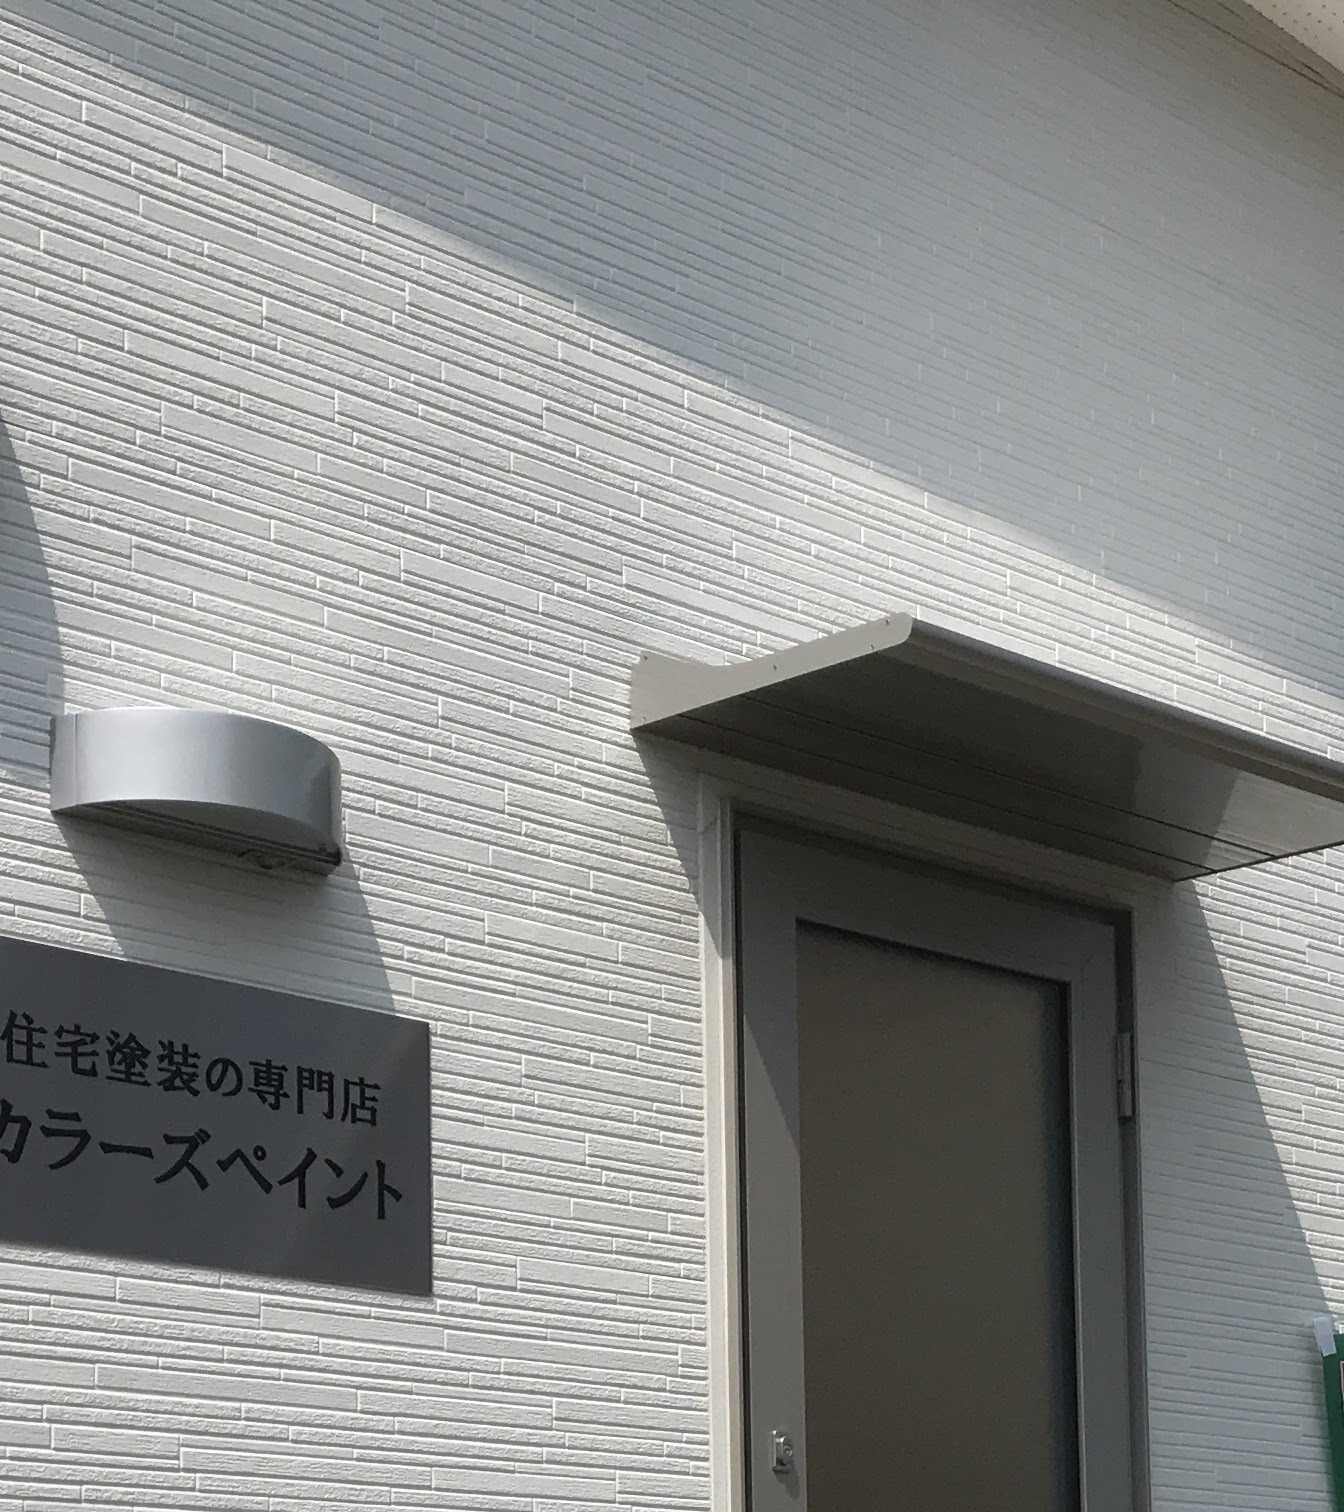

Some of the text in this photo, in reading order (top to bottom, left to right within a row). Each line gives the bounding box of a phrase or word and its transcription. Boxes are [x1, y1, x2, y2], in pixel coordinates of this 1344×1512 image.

[0, 1010, 381, 1126] 住宅塗装の専門店
